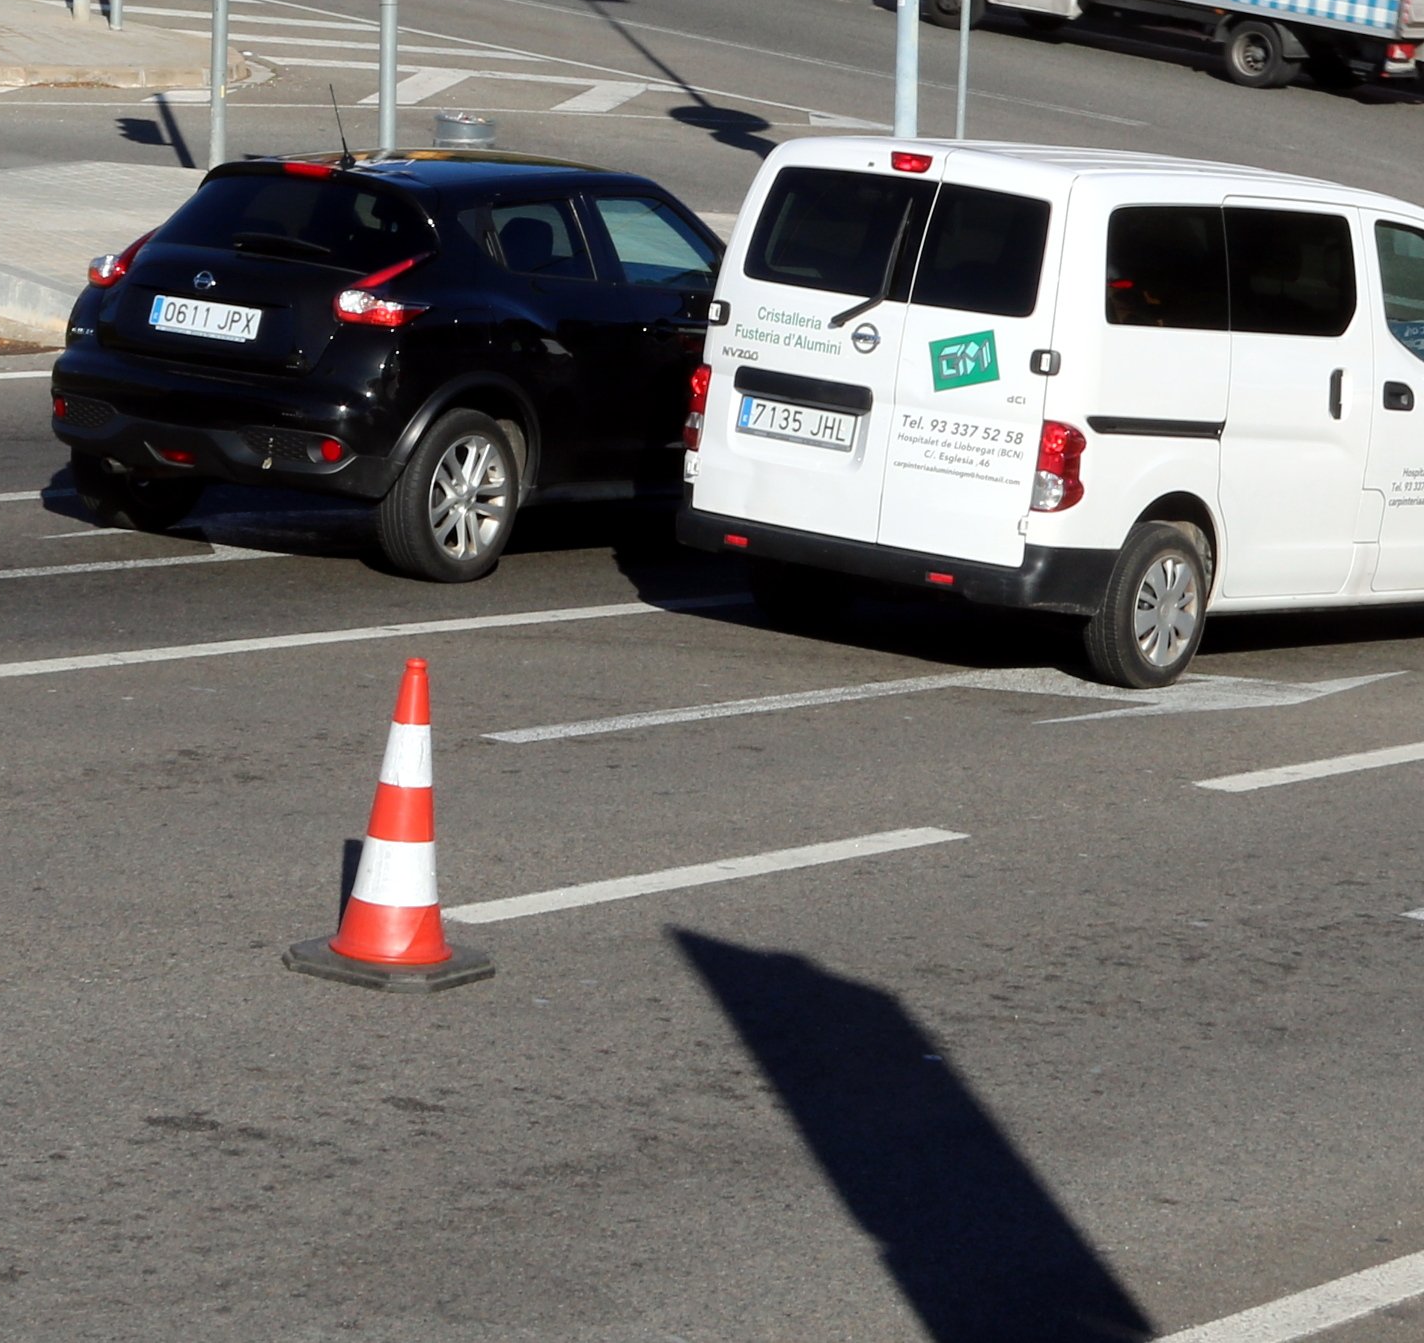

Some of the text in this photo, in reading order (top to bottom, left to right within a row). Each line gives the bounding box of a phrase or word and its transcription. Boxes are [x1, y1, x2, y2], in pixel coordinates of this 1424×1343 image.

[164, 302, 256, 335] 0611 JPX
[757, 306, 822, 331] Cristalleria
[722, 346, 759, 362] NV200
[735, 324, 780, 345] Fusteria
[783, 332, 842, 356] d'Alumini
[752, 402, 846, 442] 7135 JHL
[902, 414, 1024, 445] Tel. 93 337 52 58
[897, 432, 1024, 461] Hospitalet de Llobregat (BCN)
[939, 451, 974, 465] Esglesia
